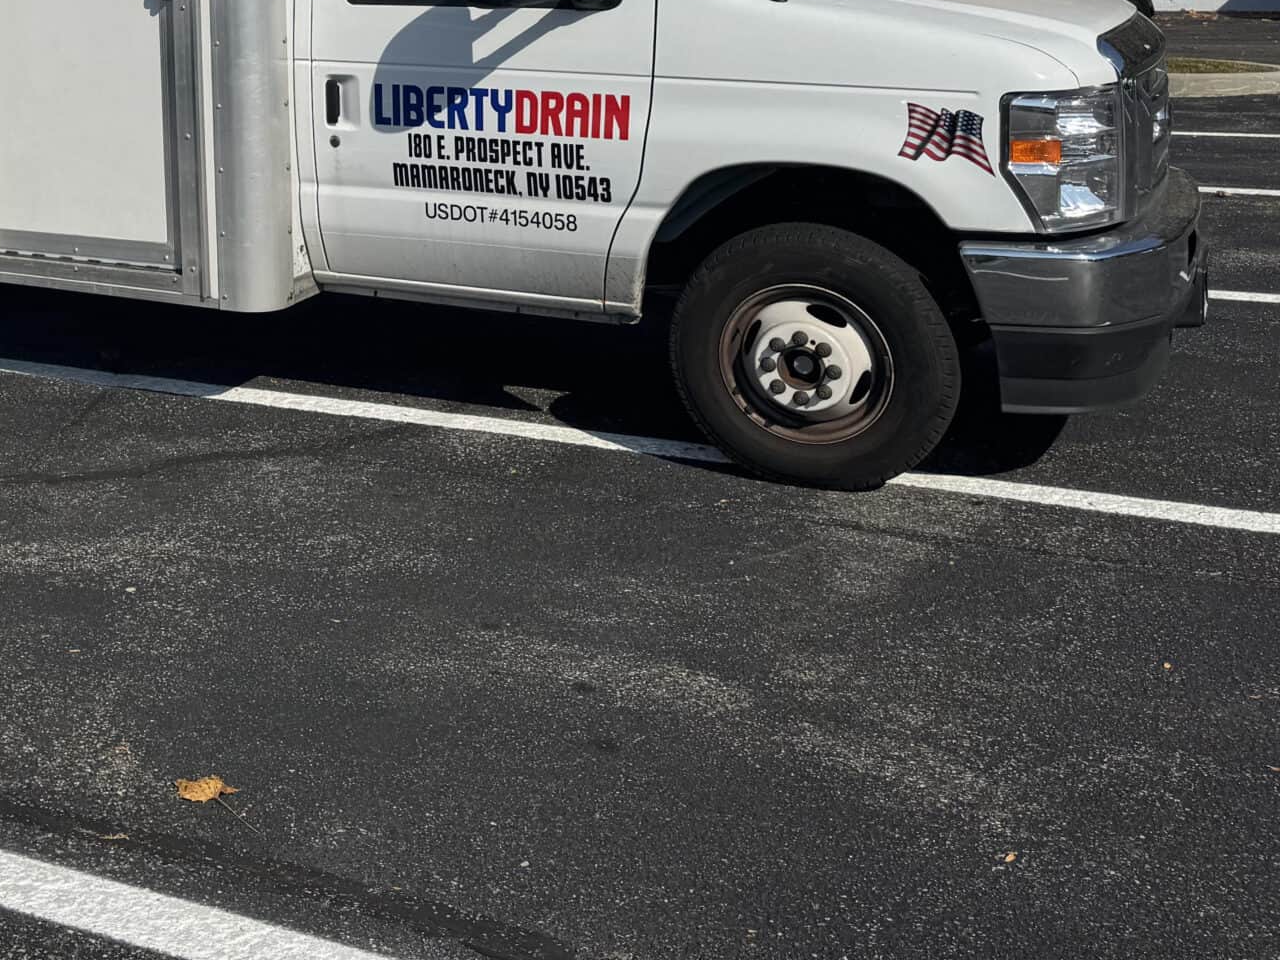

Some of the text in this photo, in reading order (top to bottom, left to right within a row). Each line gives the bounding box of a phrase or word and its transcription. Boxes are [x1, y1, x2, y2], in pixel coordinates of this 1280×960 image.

[373, 83, 631, 141] LIBERTYDRAIN
[407, 132, 591, 171] 180 E. PROSPECT AVE.
[392, 162, 613, 204] MAMARONECK, NY 10543
[424, 201, 578, 232] USDOT#4154058
